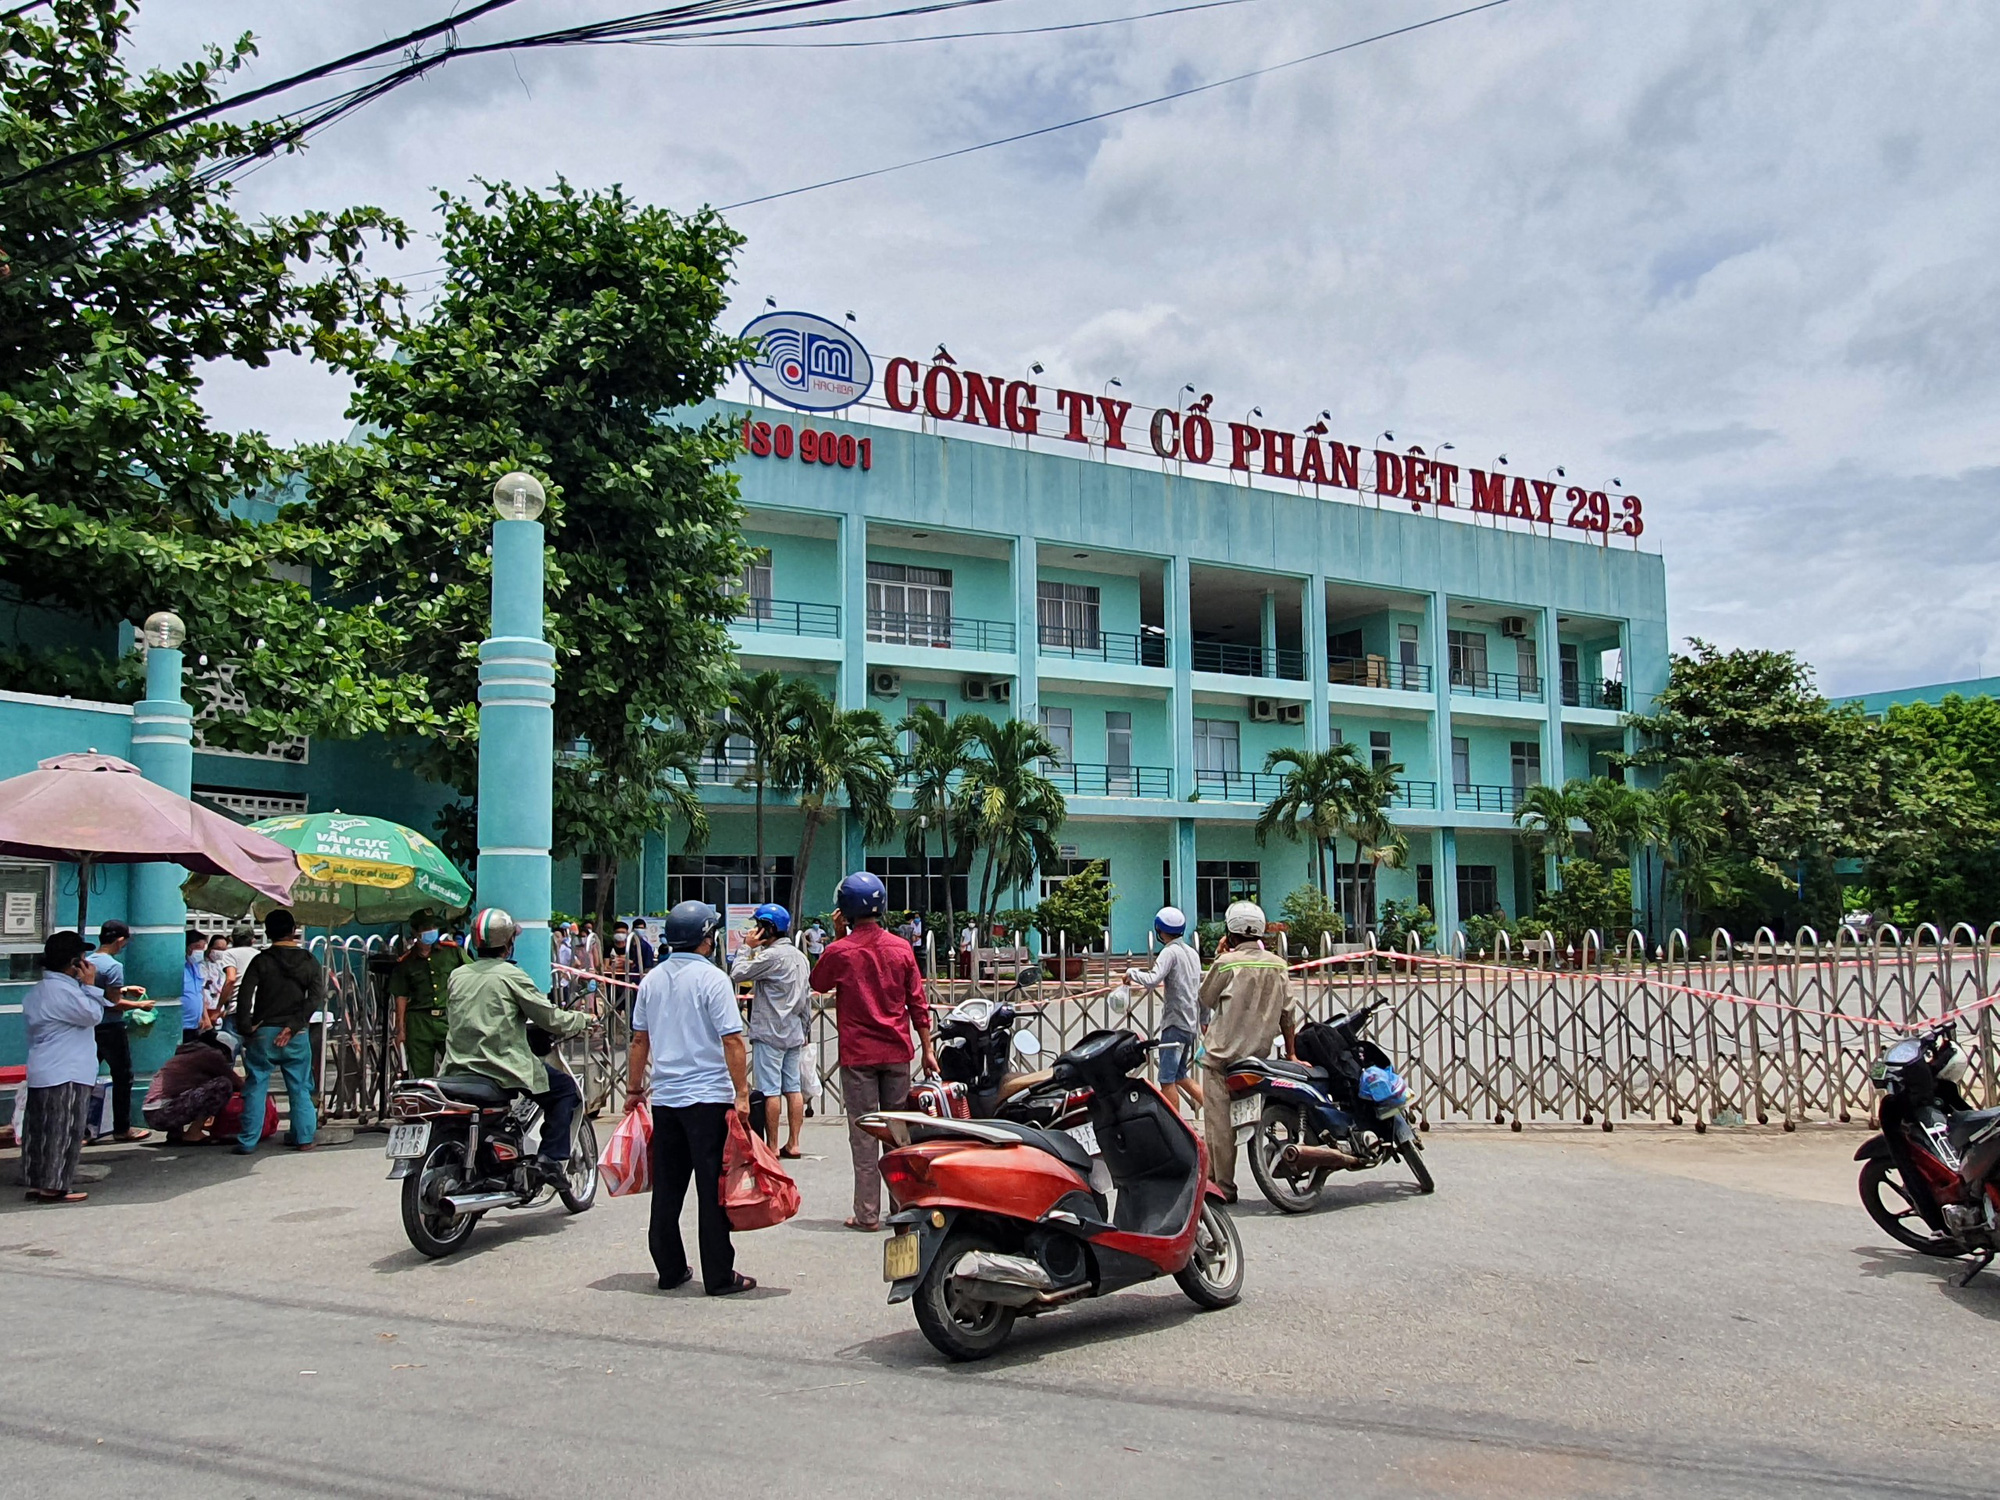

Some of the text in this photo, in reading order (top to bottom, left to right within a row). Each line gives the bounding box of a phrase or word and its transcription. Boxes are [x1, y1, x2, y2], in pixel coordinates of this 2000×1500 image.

[741, 420, 872, 470] ISO 9001
[884, 351, 1643, 536] CÔNG TY CỔ PHẦN DỆT MAY 29-3
[345, 848, 391, 860] KHÁT
[354, 838, 390, 849] CỰC
